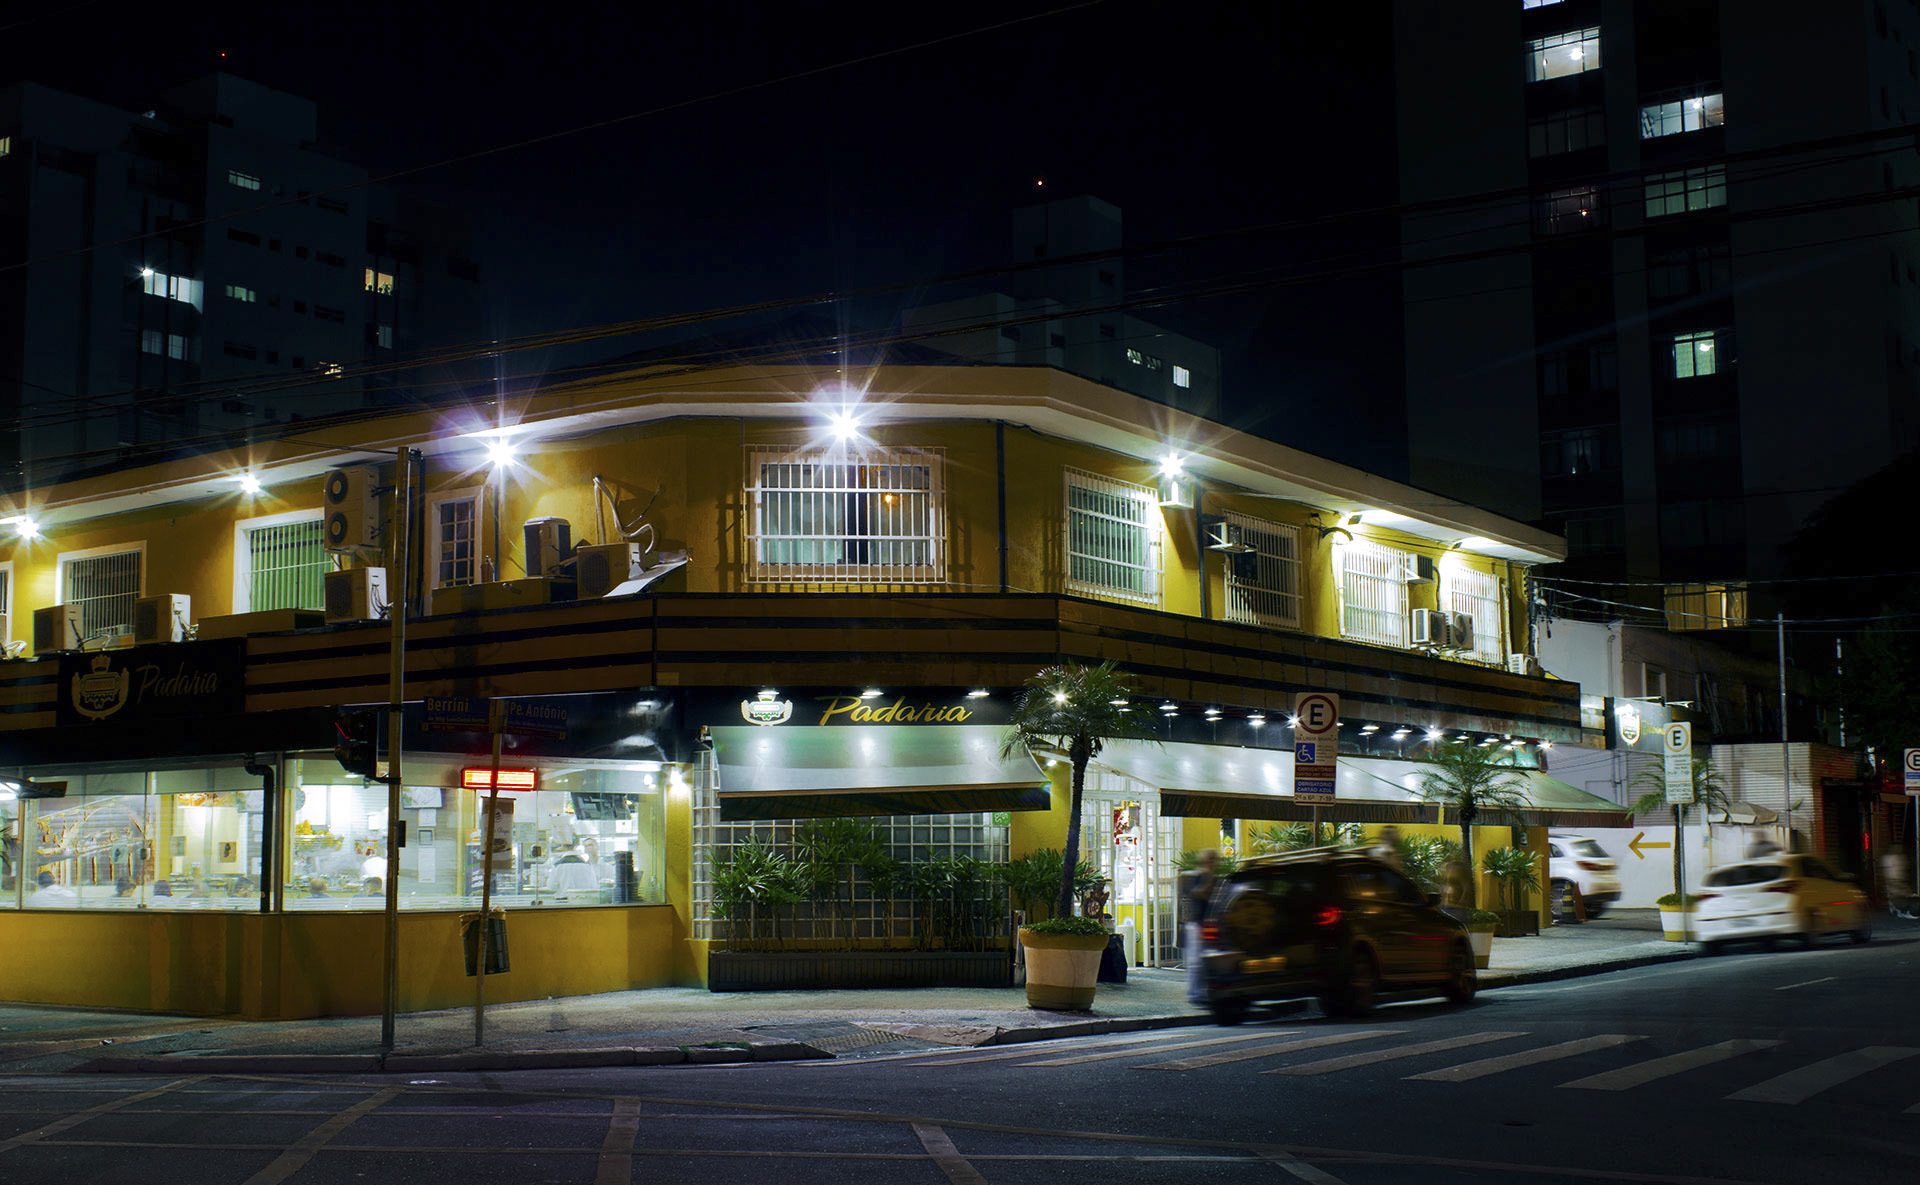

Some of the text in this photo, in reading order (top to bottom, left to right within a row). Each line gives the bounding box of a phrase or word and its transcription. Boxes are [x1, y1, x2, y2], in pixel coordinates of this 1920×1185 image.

[135, 662, 218, 704] Padaria
[427, 697, 469, 713] Berrini
[525, 704, 567, 721] Antônio
[814, 695, 974, 726] Padaria
[1310, 704, 1324, 725] E
[1672, 730, 1682, 746] E
